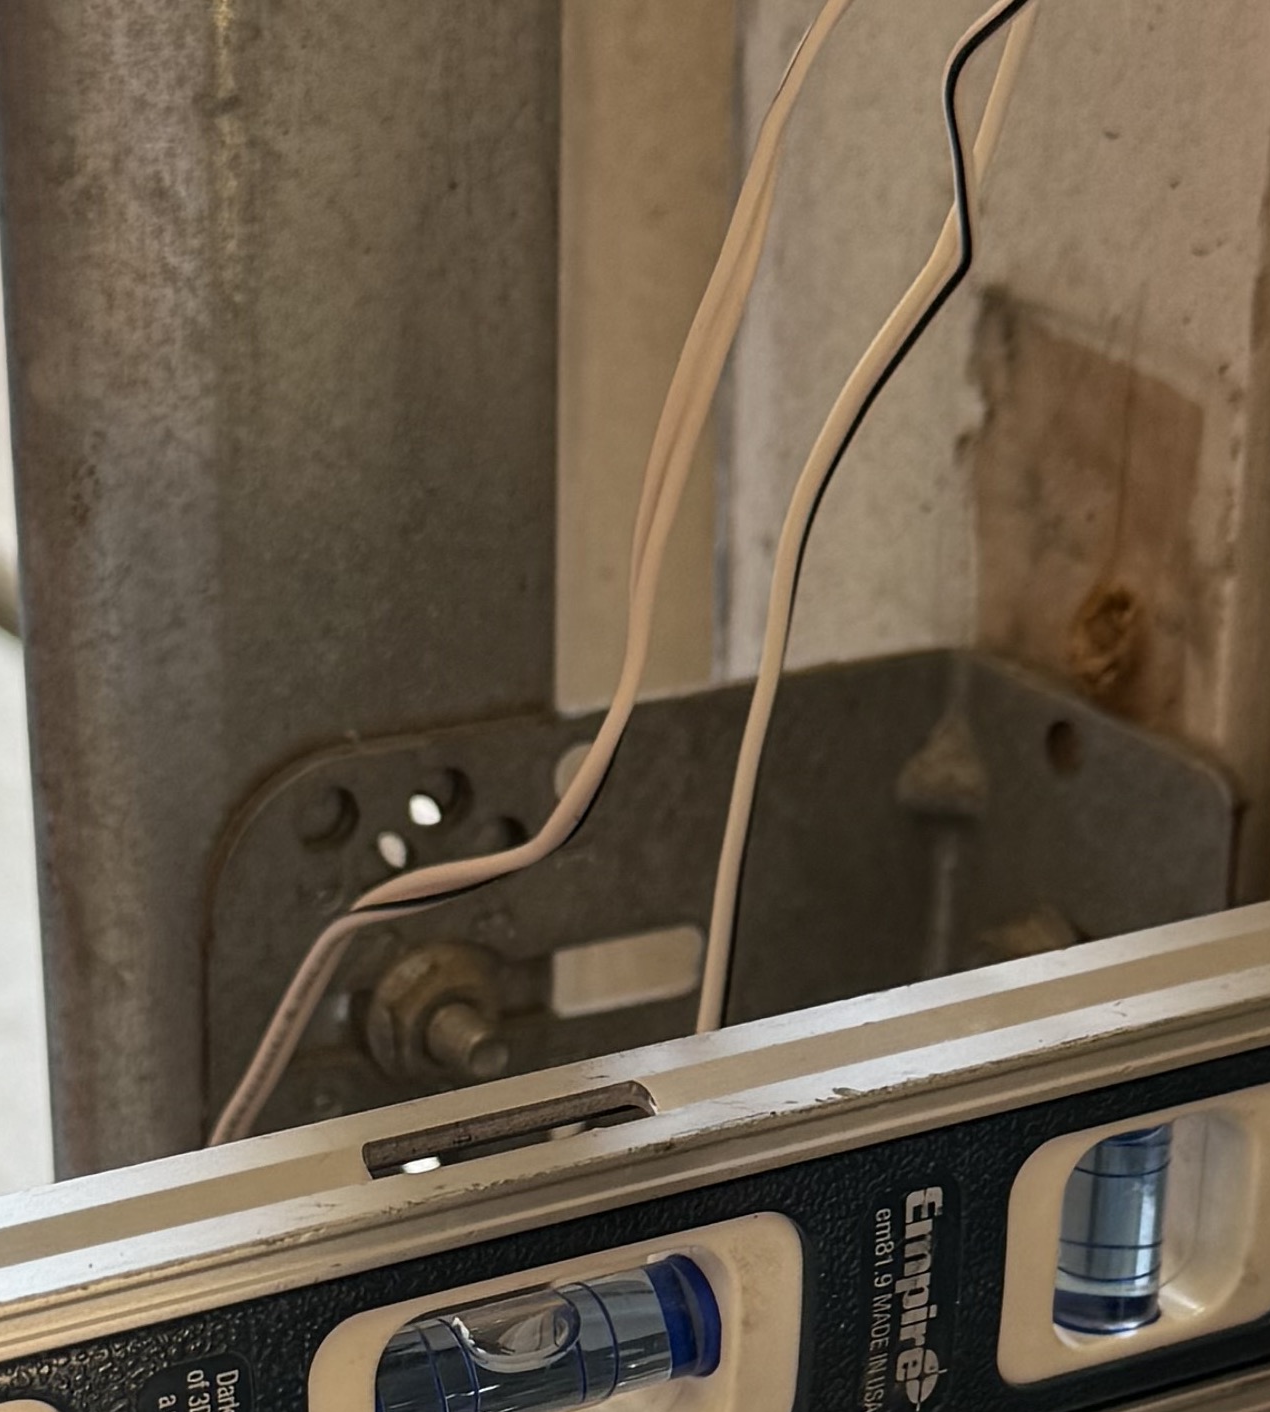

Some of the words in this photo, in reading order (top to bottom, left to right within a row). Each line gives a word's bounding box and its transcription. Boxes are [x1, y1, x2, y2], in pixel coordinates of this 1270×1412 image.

[873, 1208, 894, 1287] em81.9
[895, 1186, 943, 1386] Empire
[869, 1293, 892, 1351] MADE
[186, 1370, 210, 1389] of
[867, 1354, 887, 1374] IN
[158, 1395, 178, 1408] a
